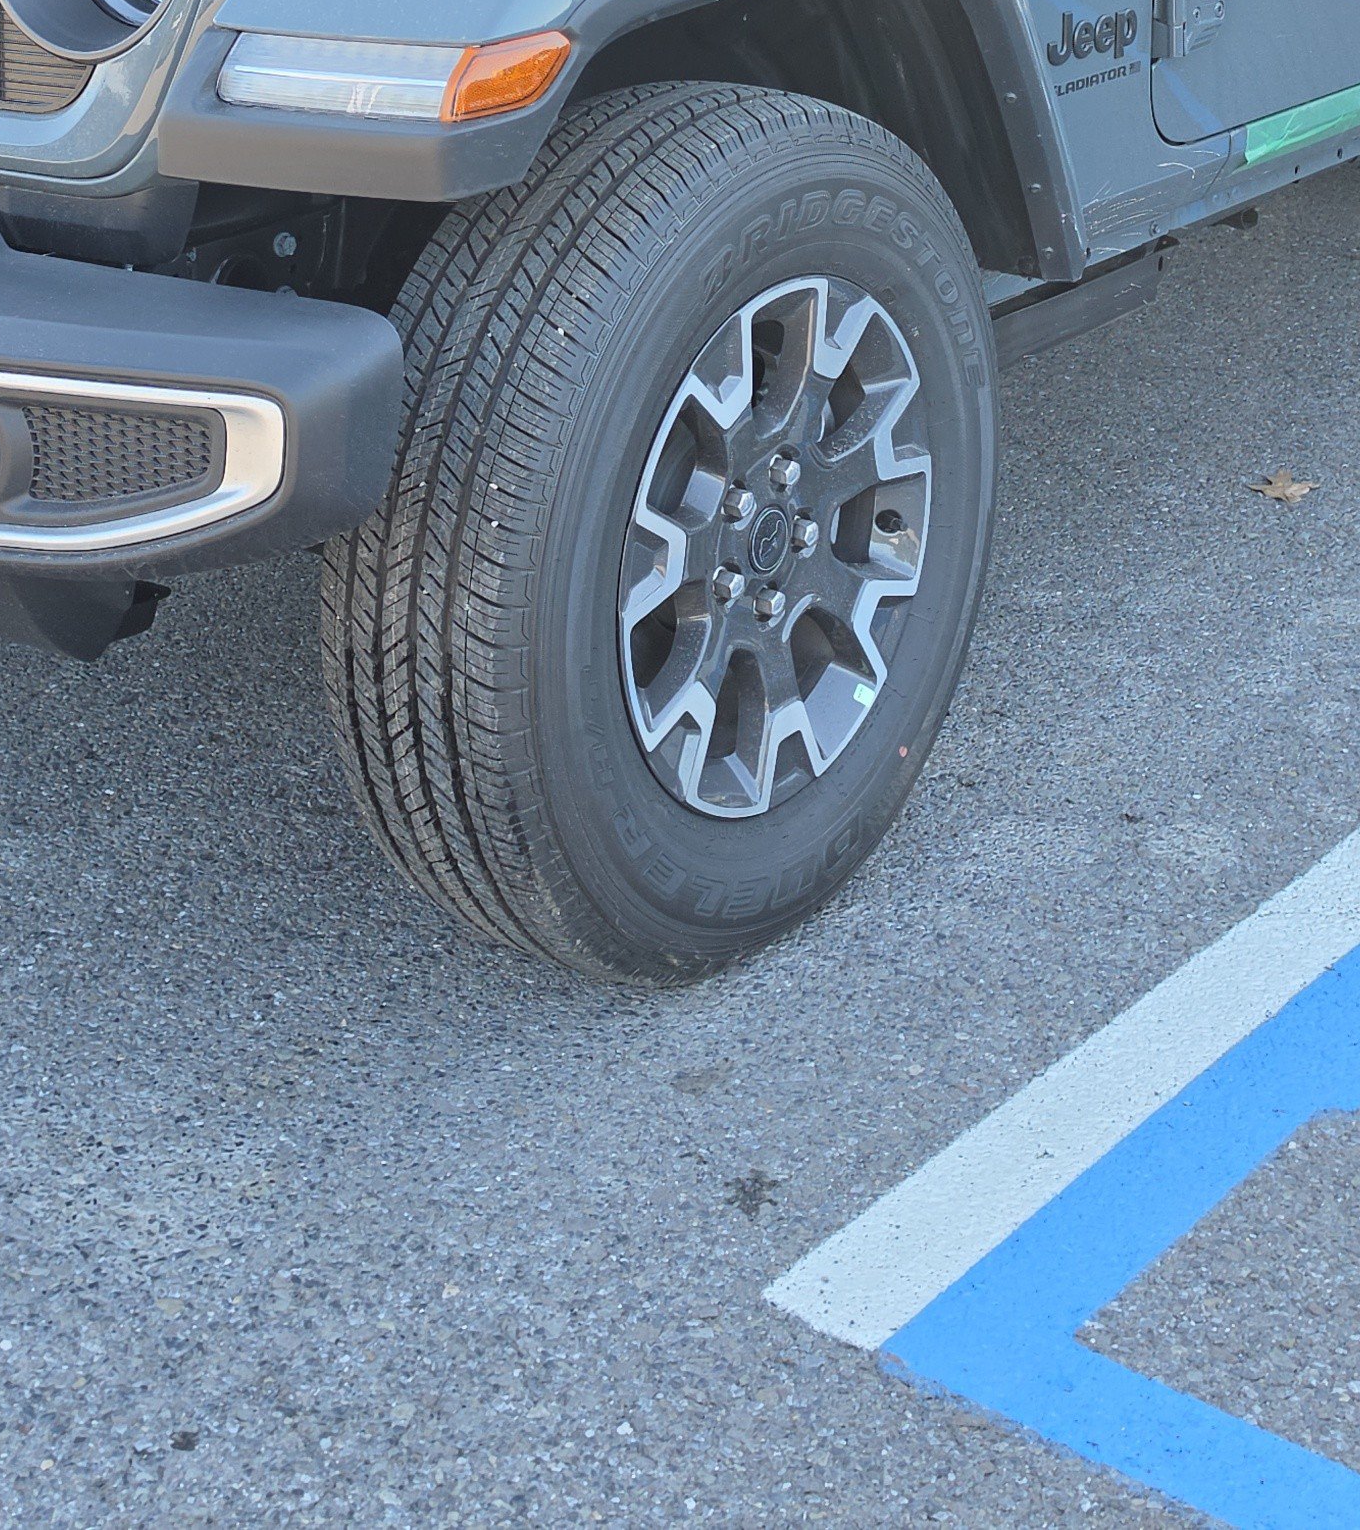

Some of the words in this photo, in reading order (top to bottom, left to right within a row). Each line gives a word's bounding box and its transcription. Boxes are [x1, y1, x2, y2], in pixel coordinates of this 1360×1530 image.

[1046, 8, 1138, 67] Jeep
[699, 189, 983, 388] BRIDGESTONE
[611, 804, 863, 918] DUELER
